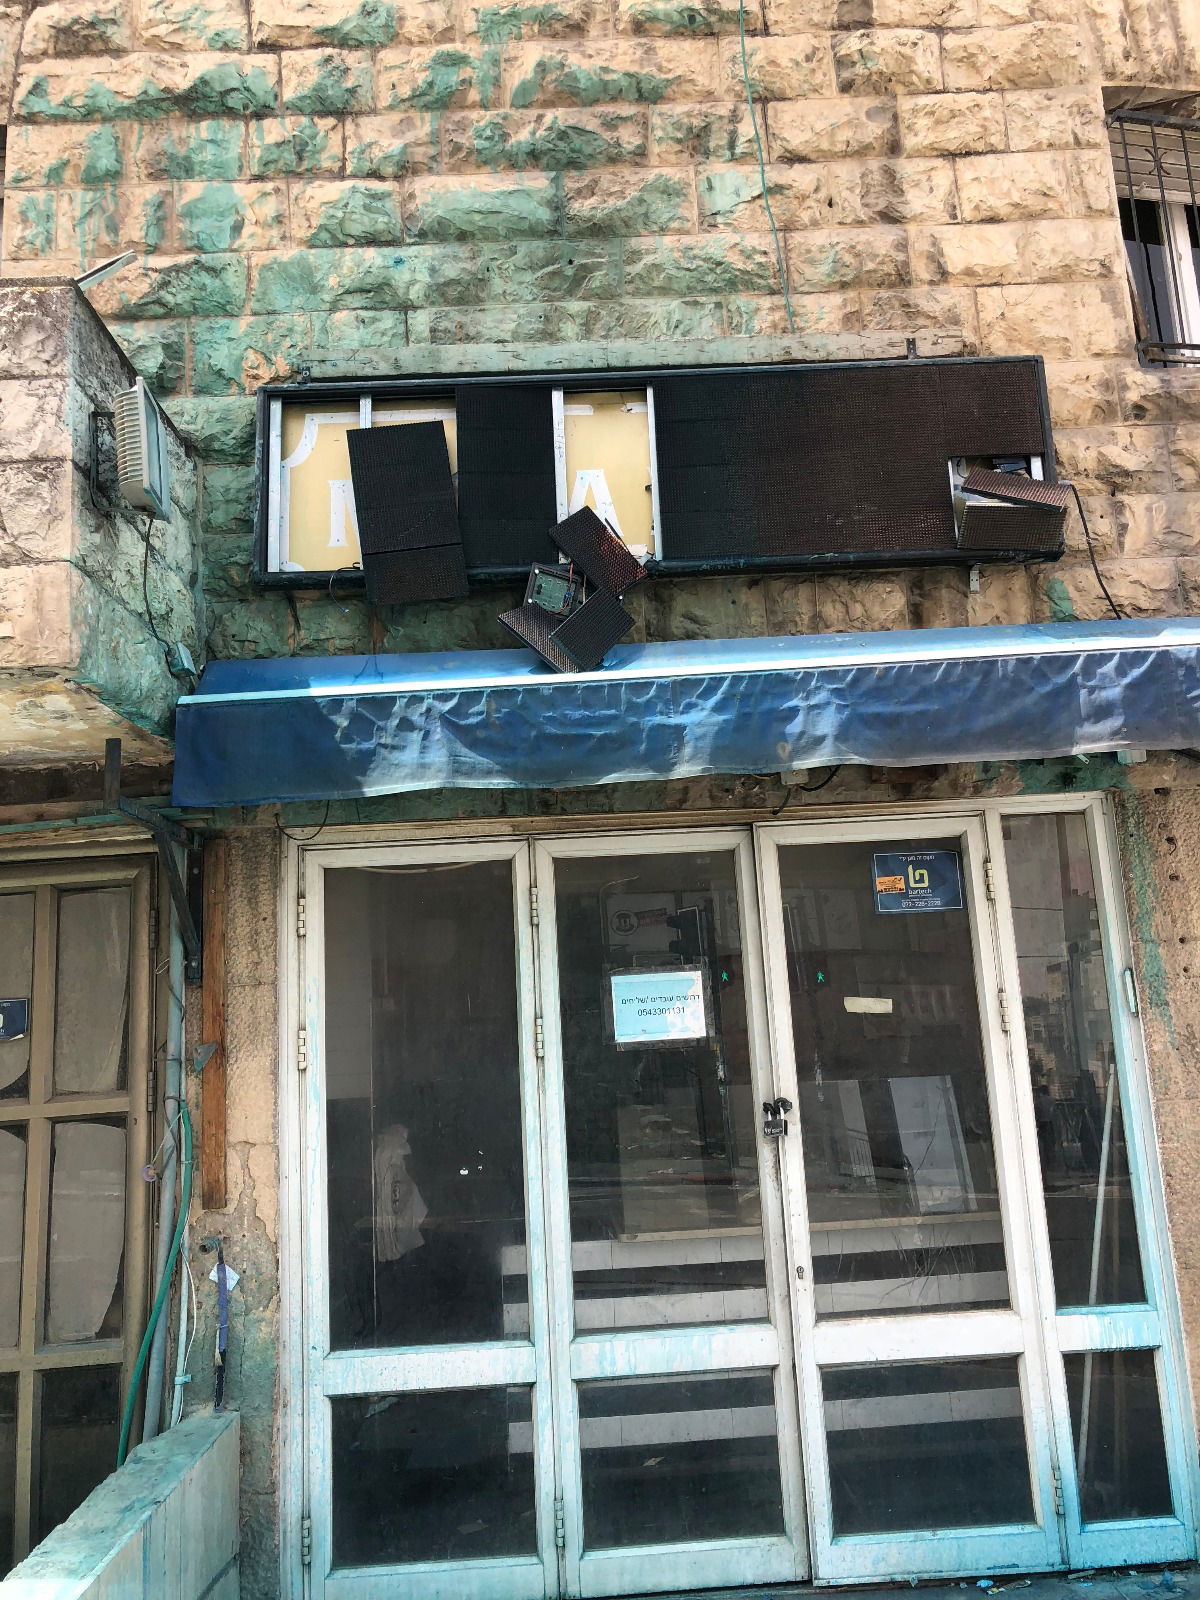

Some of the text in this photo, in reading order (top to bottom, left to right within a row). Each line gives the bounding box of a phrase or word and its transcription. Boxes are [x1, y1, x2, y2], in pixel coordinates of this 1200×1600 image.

[650, 995, 674, 1003] עובדים
[676, 994, 700, 1002] דרושים
[637, 1006, 685, 1017] 0543301131
